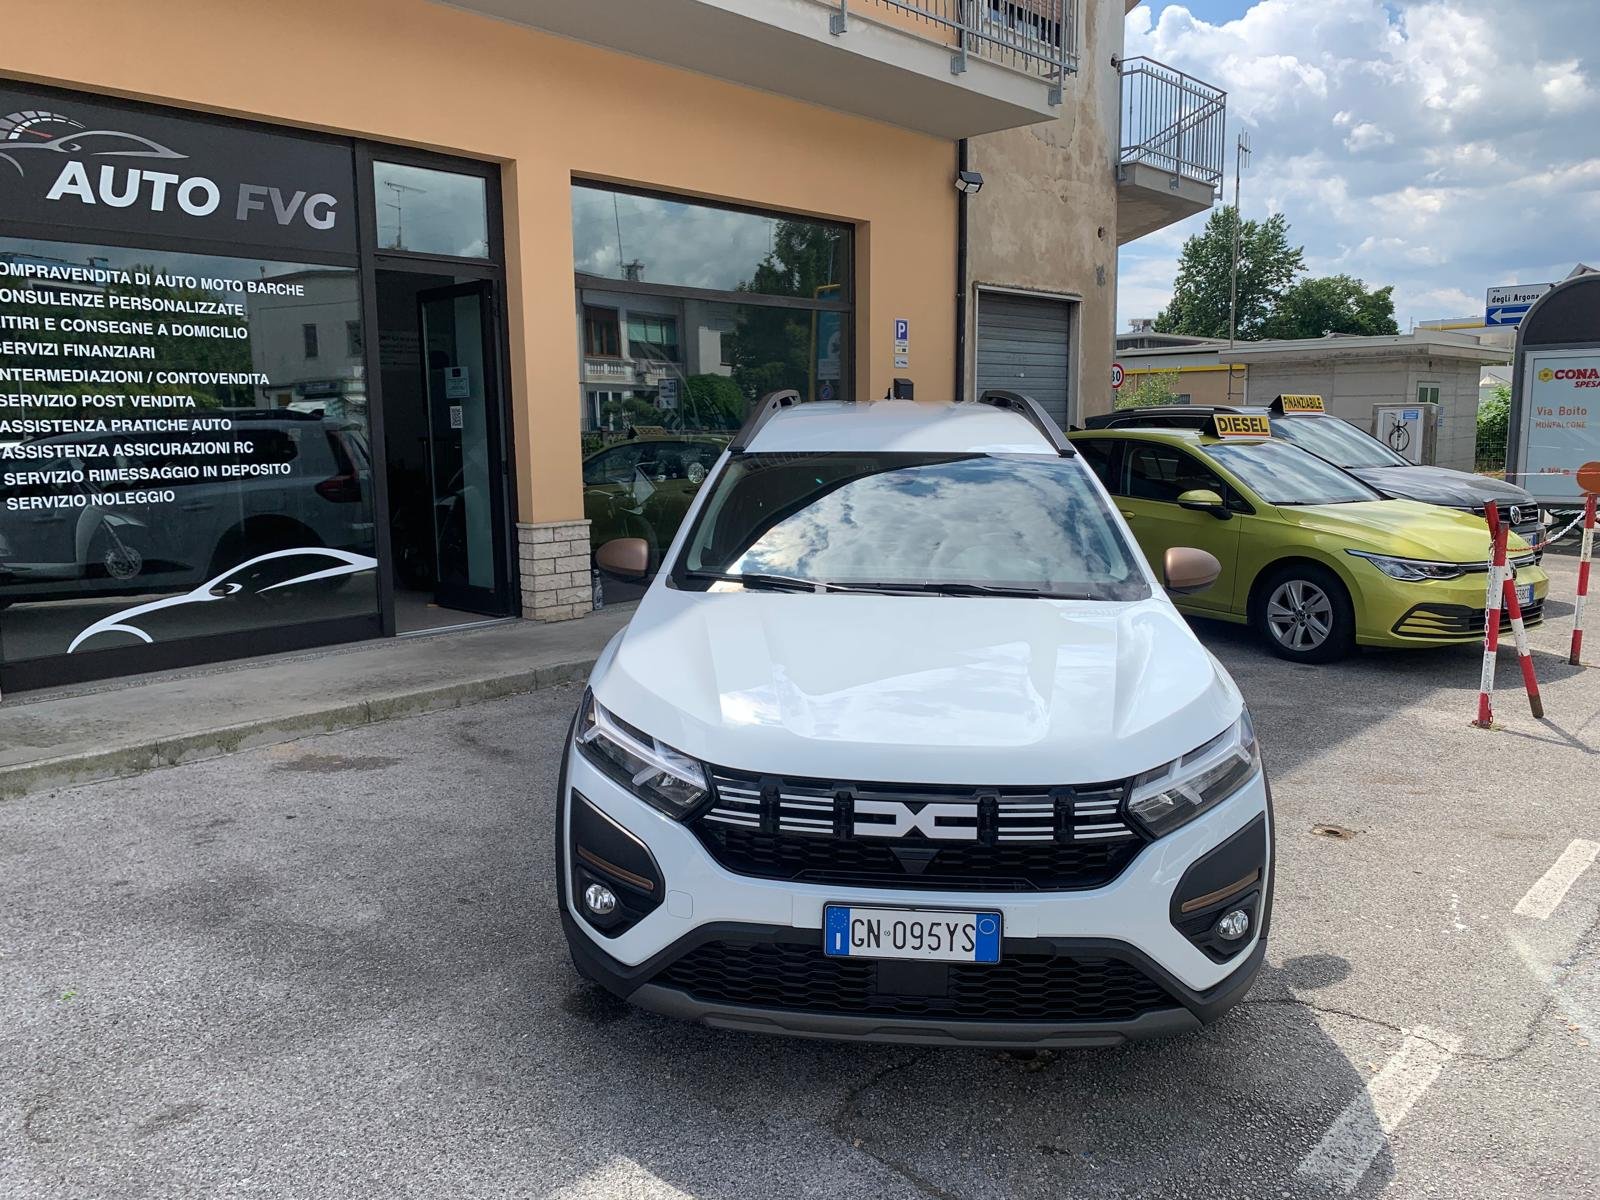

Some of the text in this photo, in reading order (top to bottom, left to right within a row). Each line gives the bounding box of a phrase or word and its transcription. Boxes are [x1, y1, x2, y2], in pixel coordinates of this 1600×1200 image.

[46, 161, 338, 230] AUTO FVG
[0, 261, 305, 297] OMPRAVENDITA DI AUTO MOTO BARCHE
[0, 288, 244, 316] ONSULENZE PERSONALIZZATE
[1491, 294, 1511, 304] degli
[0, 315, 248, 339] ITIRI E CONSEGNE A DOMICILIO
[898, 322, 906, 338] P
[63, 343, 156, 359] FINANZIARI
[156, 371, 270, 385] CONTOVENDITA
[0, 393, 196, 408] SERVIZIO POST VENDITA
[1283, 396, 1323, 409] FINANZIABILE
[1537, 406, 1588, 416] Via Boito
[0, 418, 232, 433] ASSISTENZA PRATICHE AUTO
[1216, 417, 1268, 432] DIESEL
[0, 441, 254, 460] ASSISTENZA ASSICURAZIONI RC
[3, 462, 291, 486] SERVIZIO RIMESSAGGIO IN DEPOSITO
[6, 490, 175, 511] SERVIZIO NOLEGGIO
[851, 918, 881, 948] GN
[892, 920, 976, 953] 095YS
